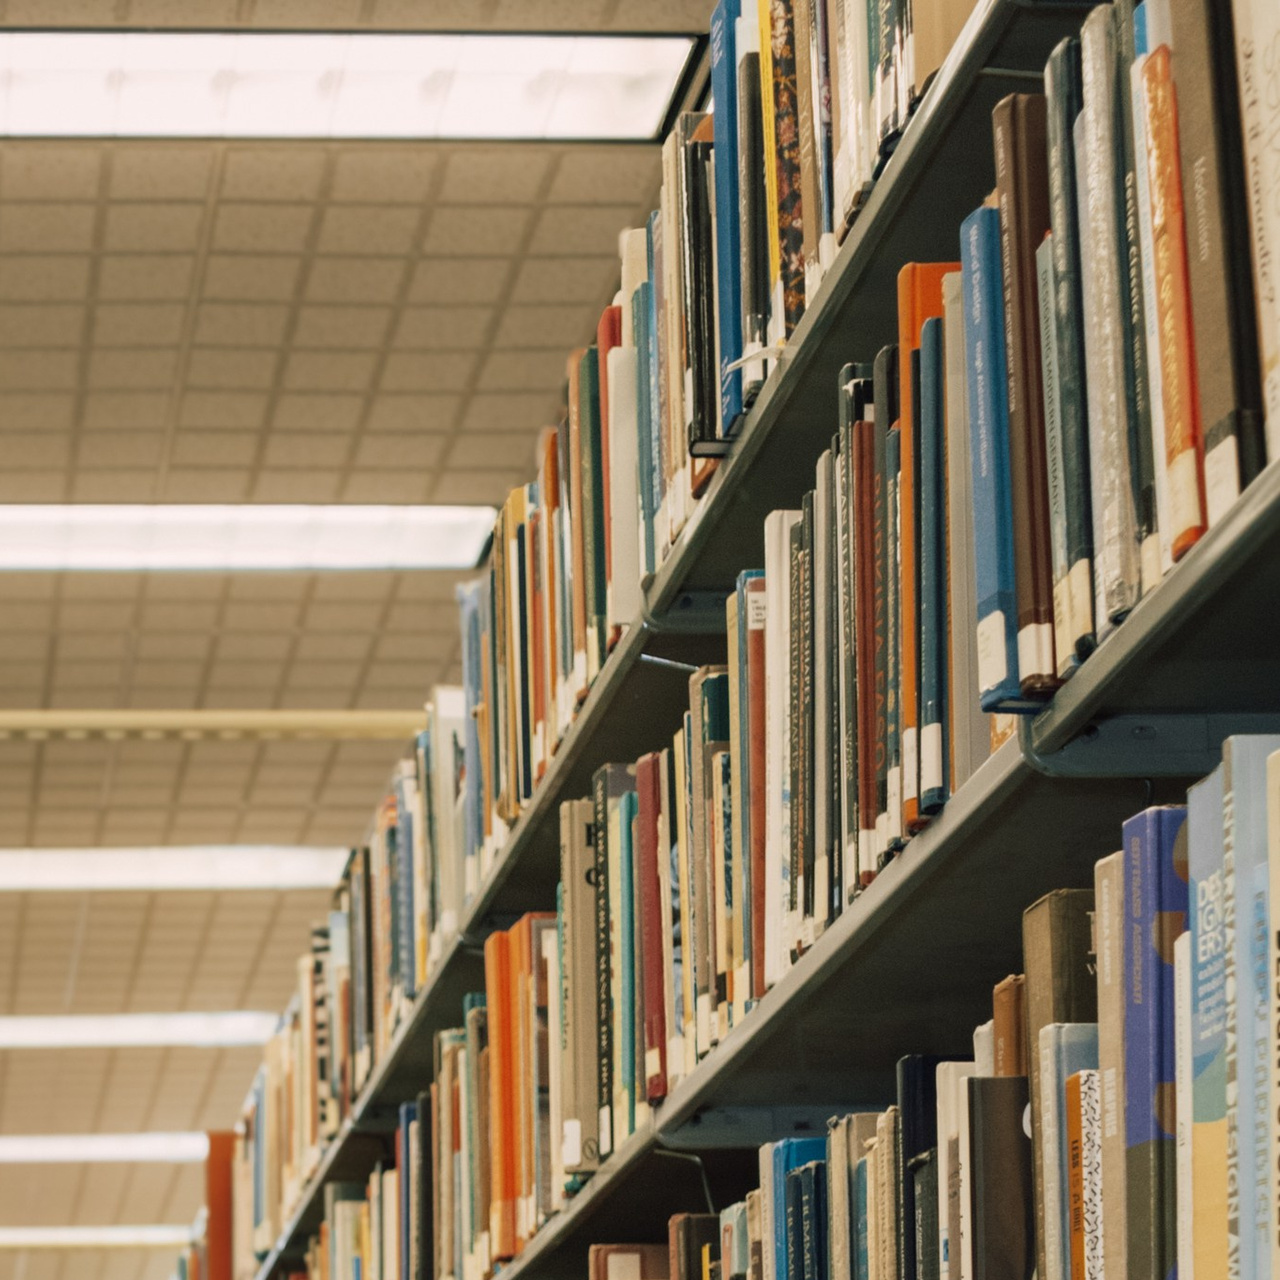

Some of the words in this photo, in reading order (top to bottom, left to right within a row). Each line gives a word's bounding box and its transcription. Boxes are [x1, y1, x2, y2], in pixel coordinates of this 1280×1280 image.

[1040, 269, 1053, 360] DESIGNING
[1044, 361, 1056, 433] MODERN
[1048, 436, 1060, 517] GERMANY
